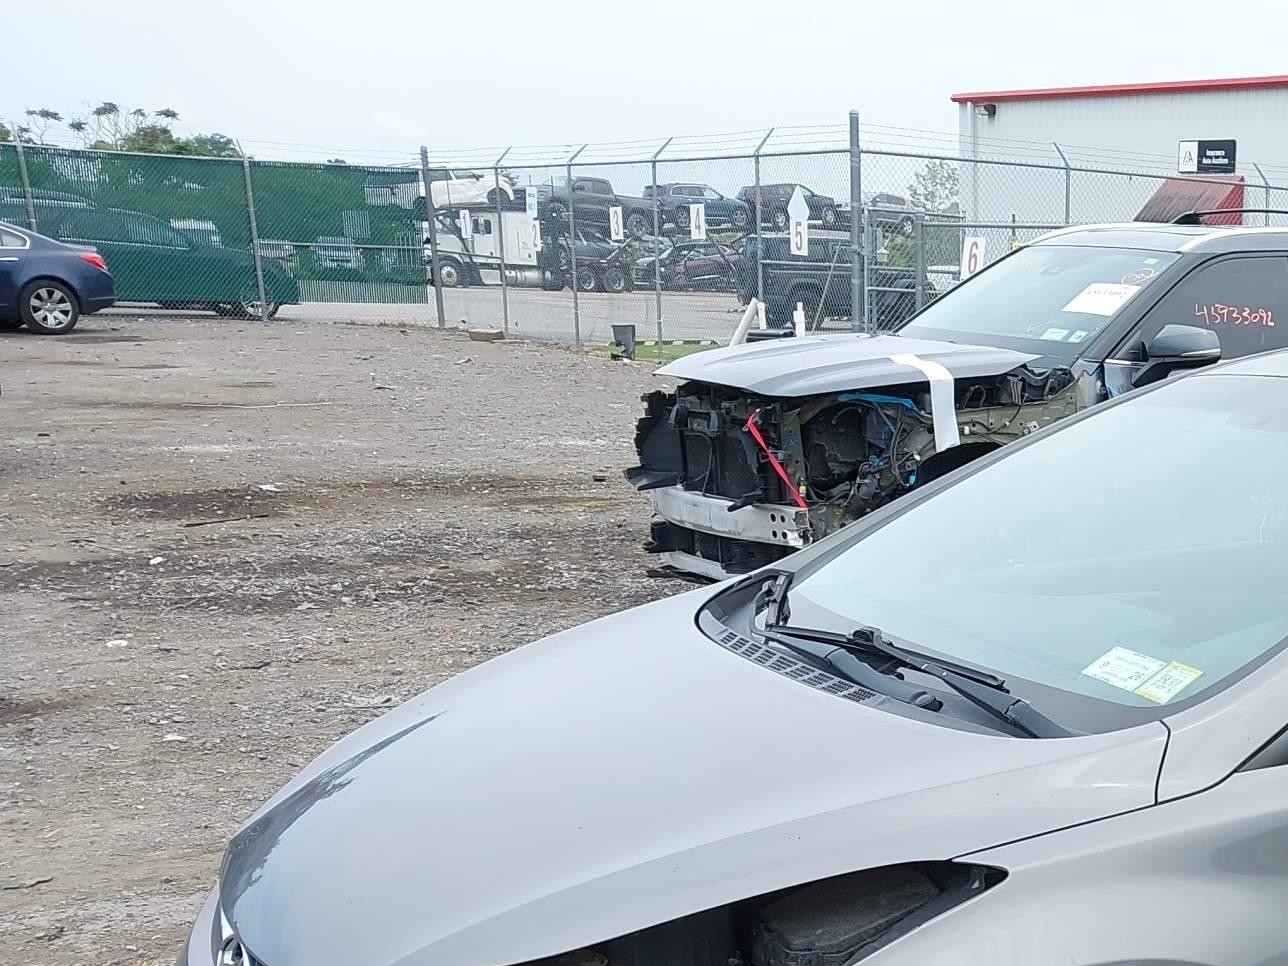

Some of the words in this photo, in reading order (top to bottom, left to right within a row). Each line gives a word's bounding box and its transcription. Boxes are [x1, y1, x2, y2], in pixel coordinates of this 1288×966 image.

[613, 210, 620, 236] 3
[694, 207, 701, 236] 4
[531, 223, 538, 248] 2
[795, 221, 803, 251] 5
[967, 240, 980, 275] 6
[1195, 303, 1275, 327] 45933092
